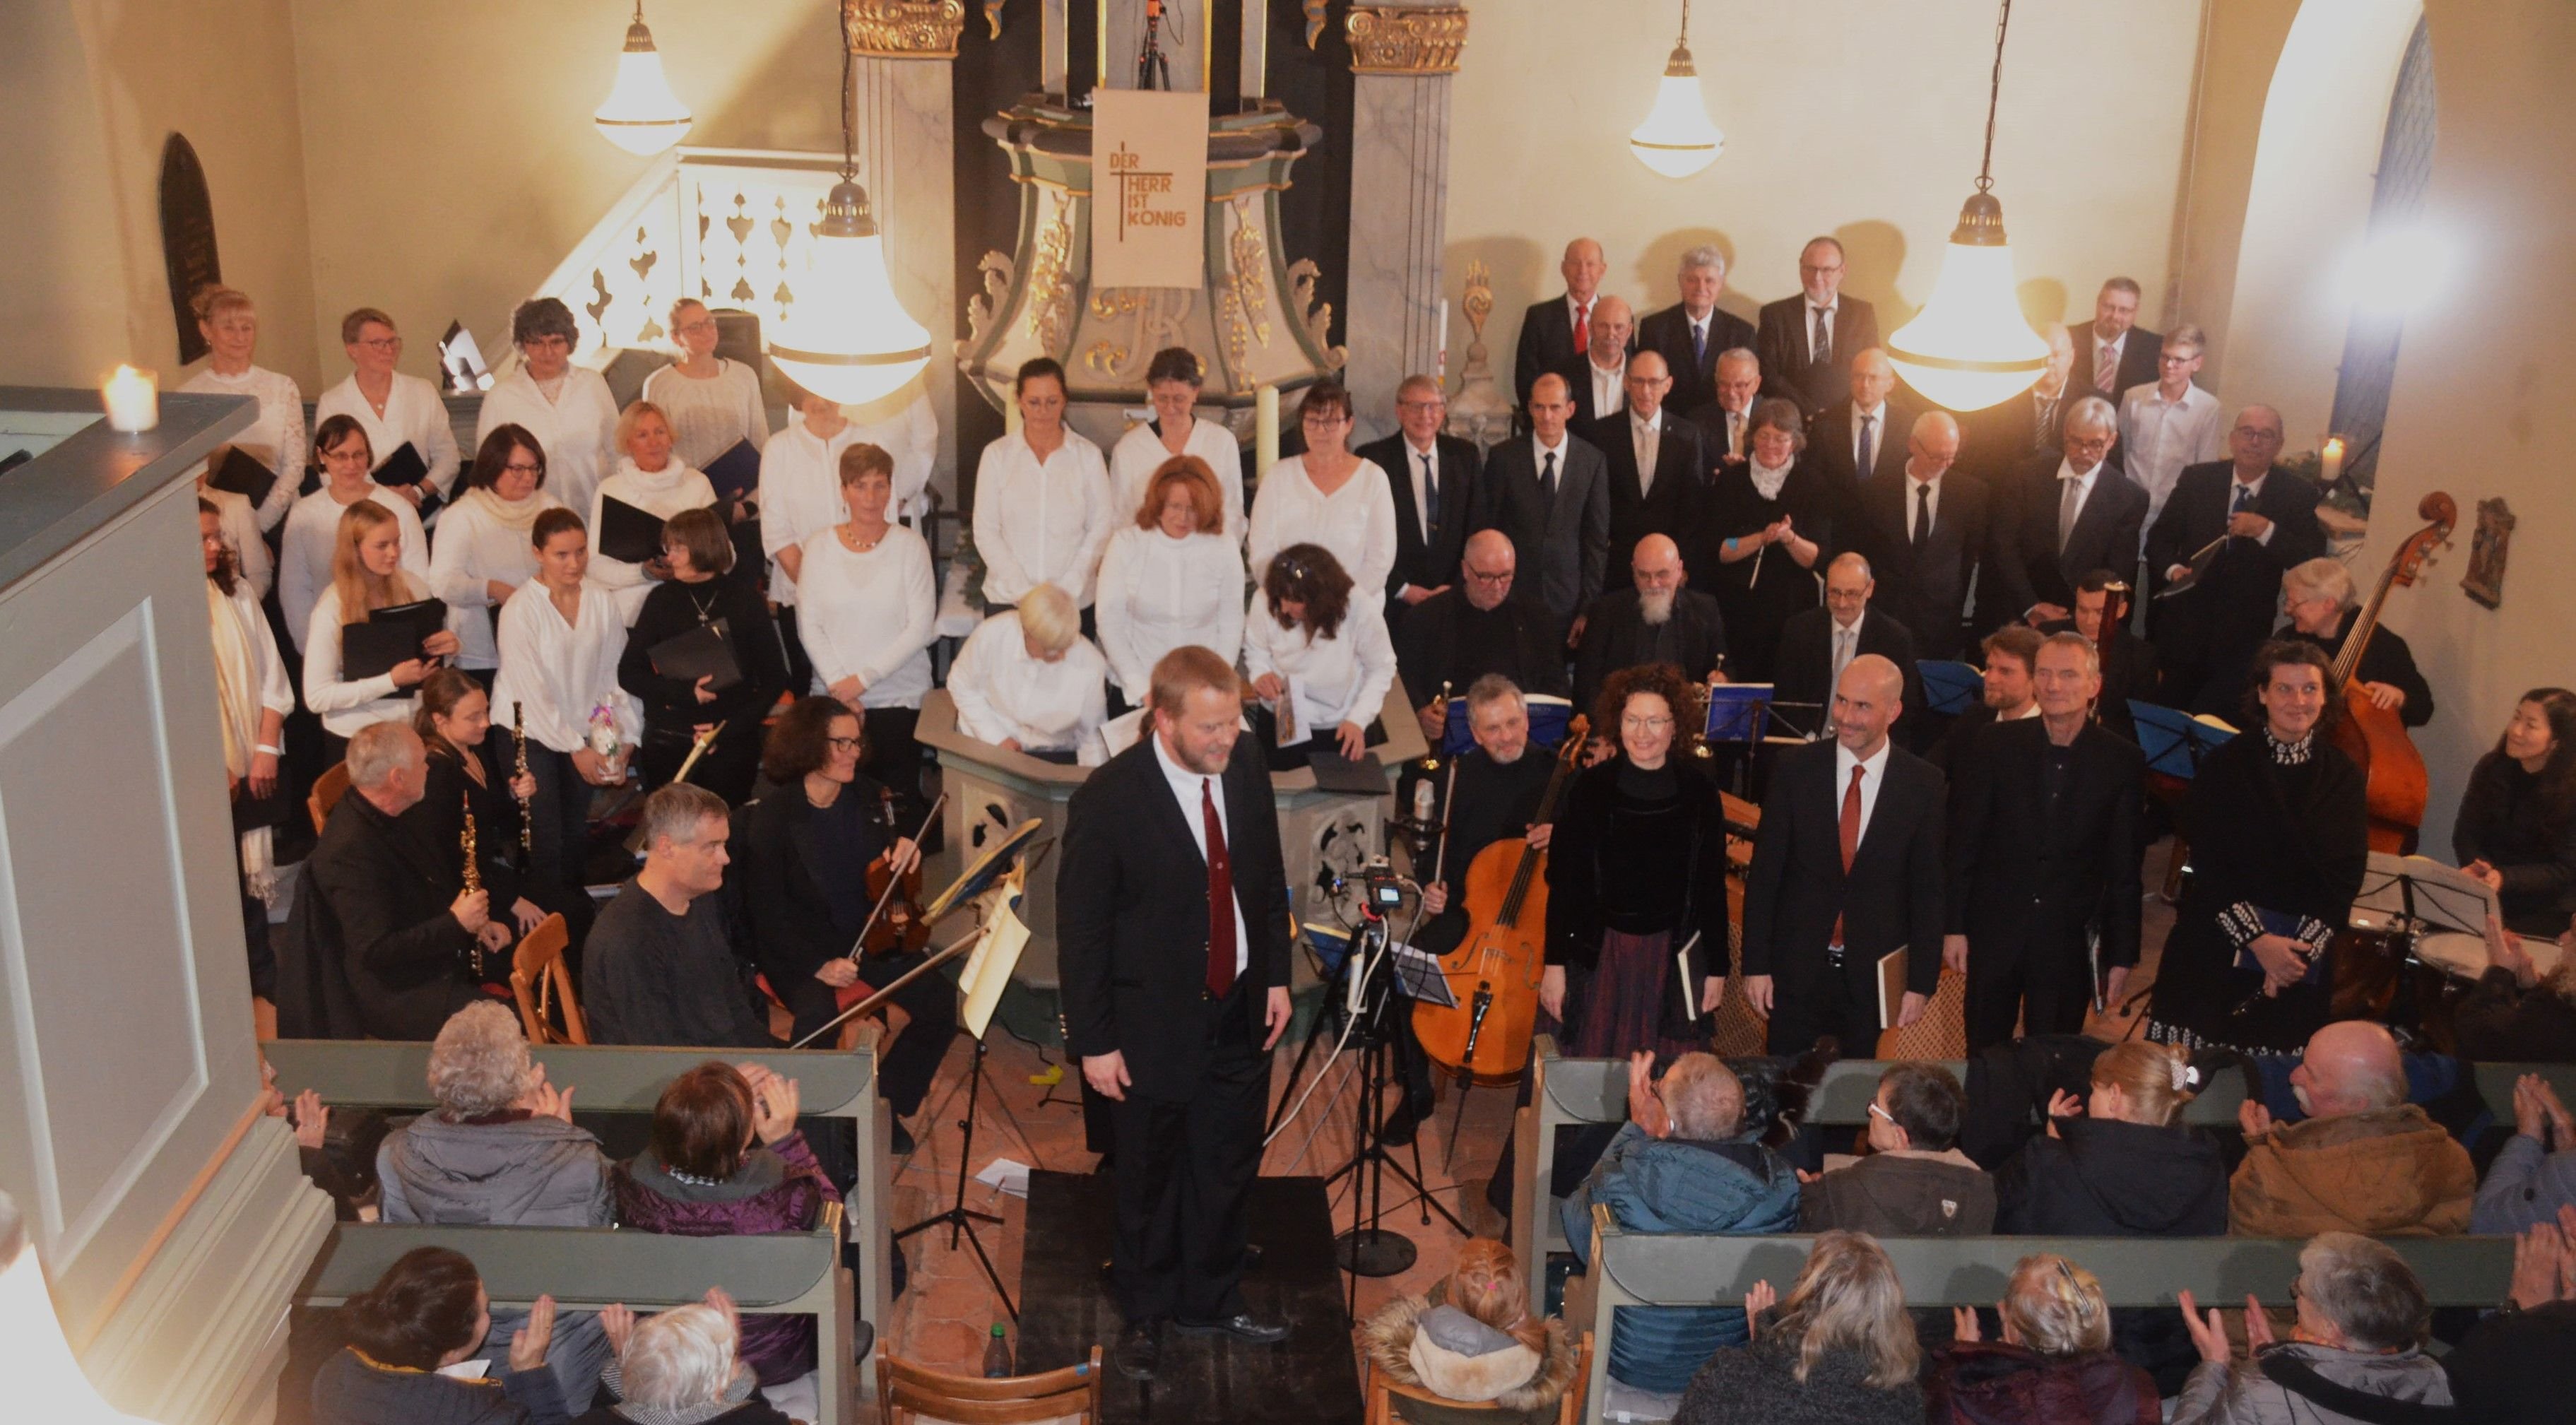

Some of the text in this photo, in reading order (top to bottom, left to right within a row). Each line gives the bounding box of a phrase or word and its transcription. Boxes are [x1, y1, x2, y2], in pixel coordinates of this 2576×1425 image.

[1110, 153, 1139, 169] DER
[1128, 177, 1172, 193] HERR
[1128, 194, 1149, 208] IST
